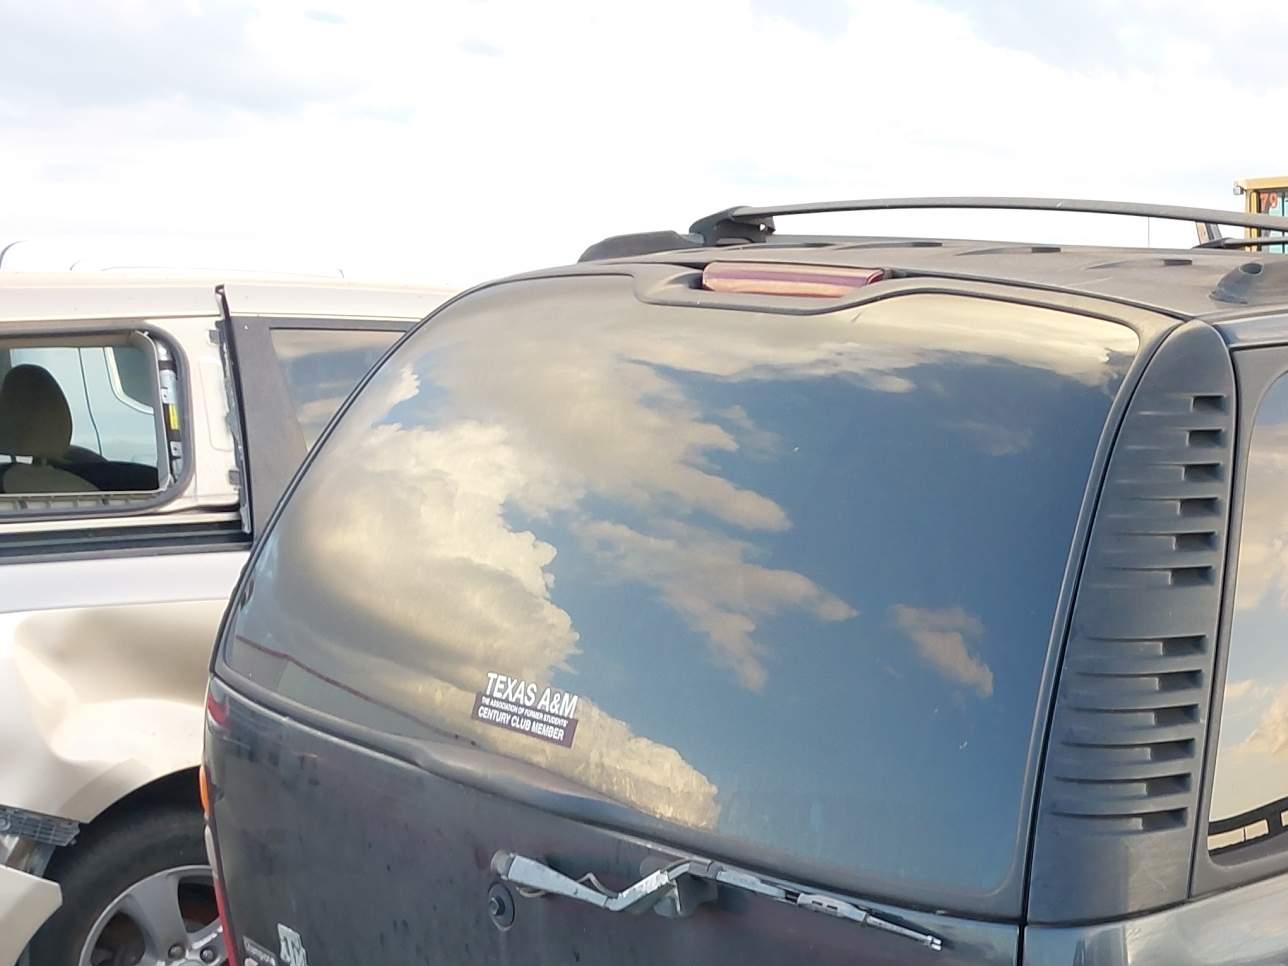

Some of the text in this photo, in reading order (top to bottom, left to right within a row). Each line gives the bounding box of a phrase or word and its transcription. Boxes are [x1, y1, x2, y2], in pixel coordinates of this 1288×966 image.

[481, 695, 490, 704] THE
[489, 697, 518, 713] ASSOCIATION
[524, 708, 543, 720] FORMER
[485, 672, 578, 719] TEXAS A&M
[478, 706, 565, 741] CENTURY CLUB MEMBER
